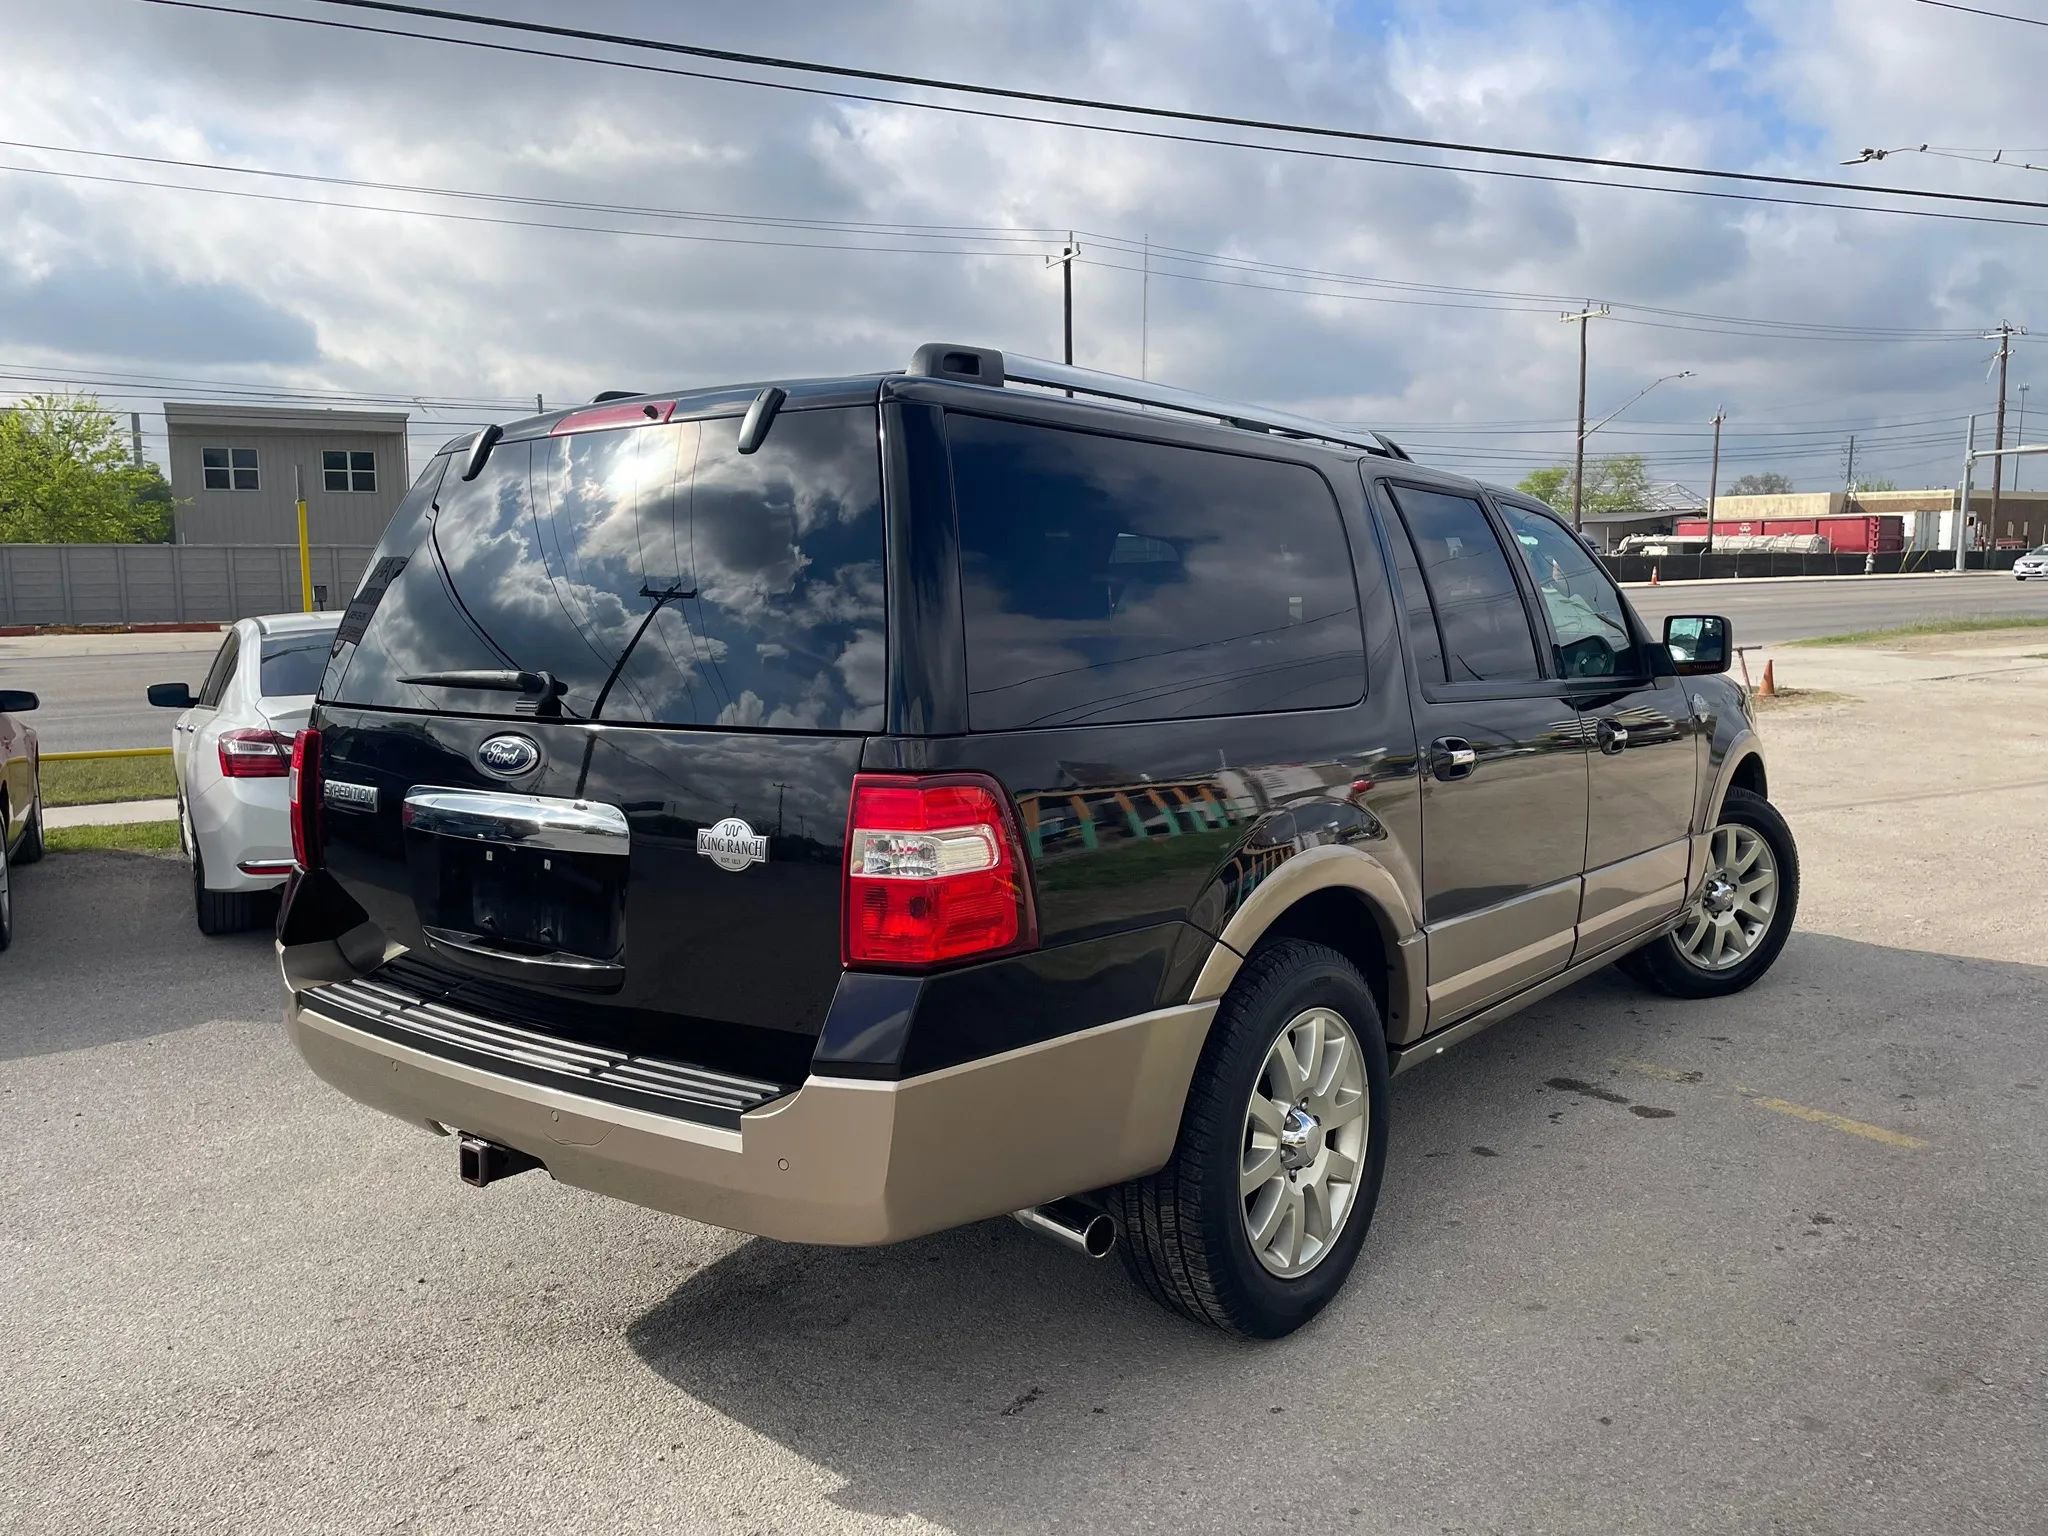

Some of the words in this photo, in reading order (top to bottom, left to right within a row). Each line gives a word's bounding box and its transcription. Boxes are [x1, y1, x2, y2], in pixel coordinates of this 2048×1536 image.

[487, 741, 520, 765] Ford
[324, 781, 376, 804] EXPEDITION
[700, 833, 725, 852] KING
[727, 839, 763, 857] RANCH
